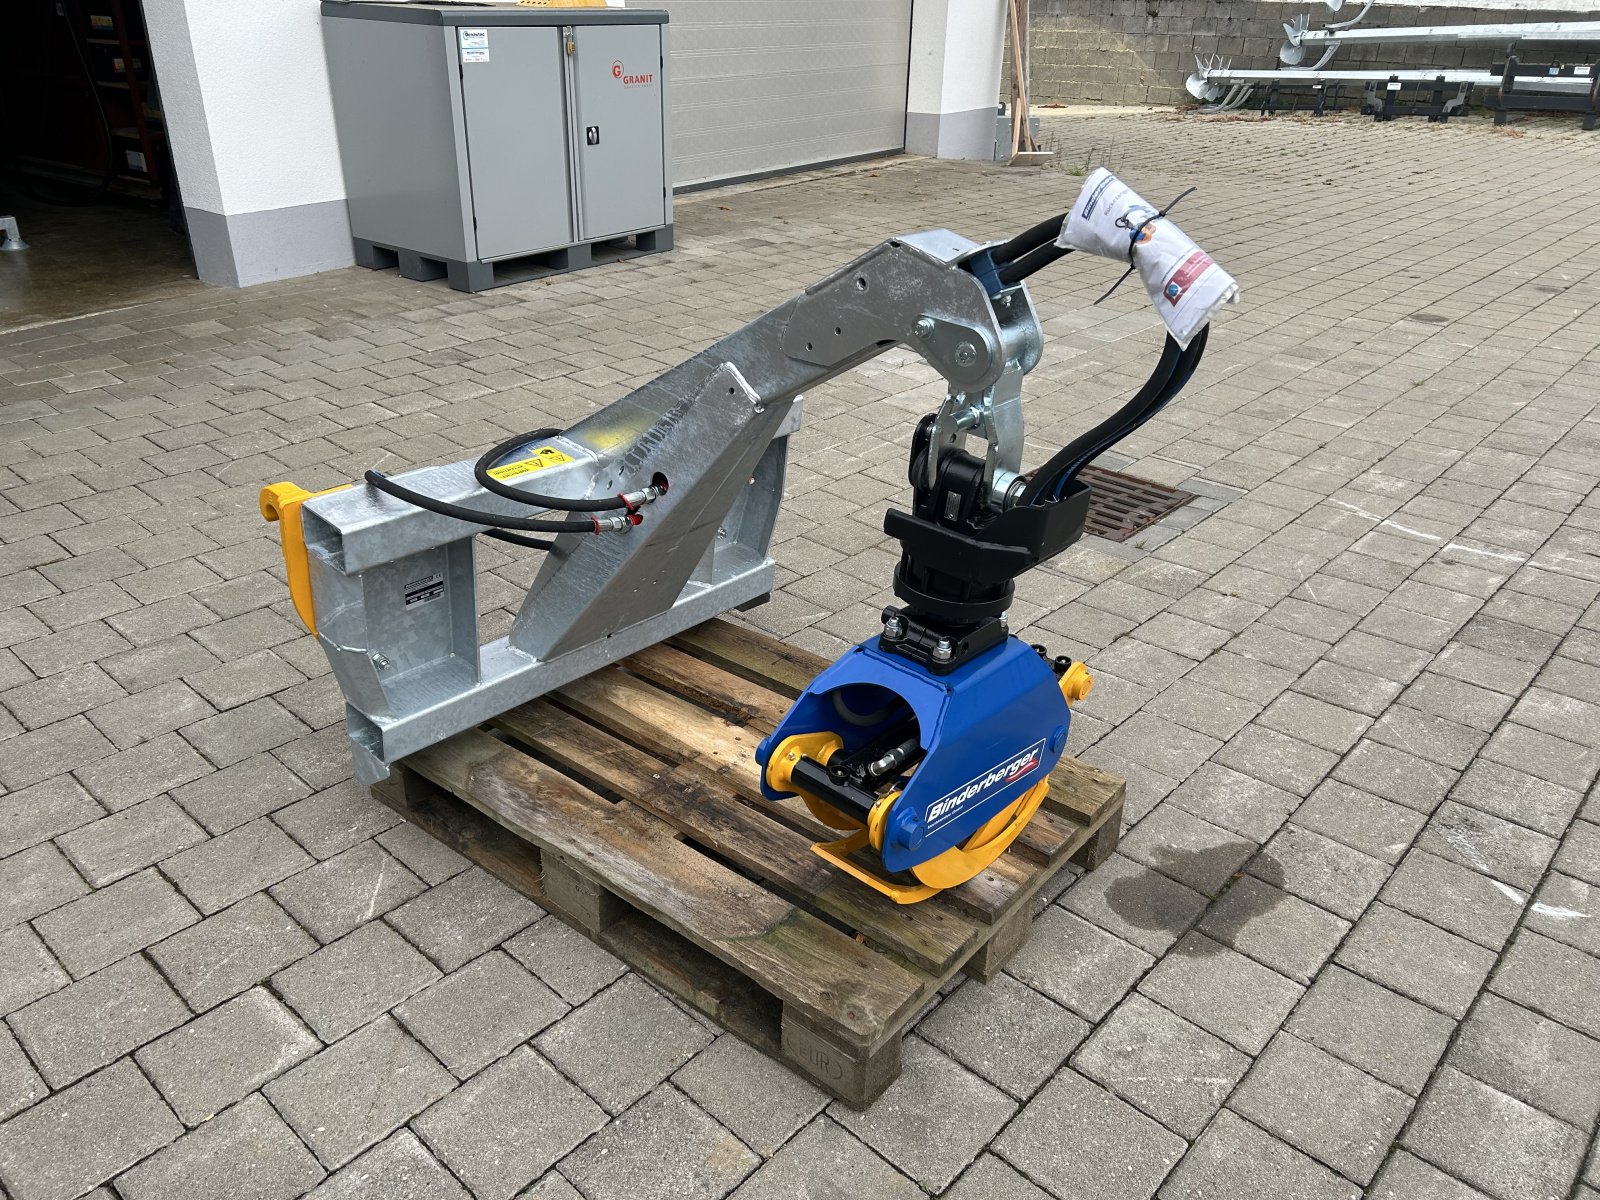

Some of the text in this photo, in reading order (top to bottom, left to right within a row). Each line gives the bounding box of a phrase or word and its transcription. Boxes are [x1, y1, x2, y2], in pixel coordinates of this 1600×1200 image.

[623, 74, 653, 85] GRANIT
[927, 747, 1039, 823] Binderberger
[799, 1036, 830, 1074] EUR
